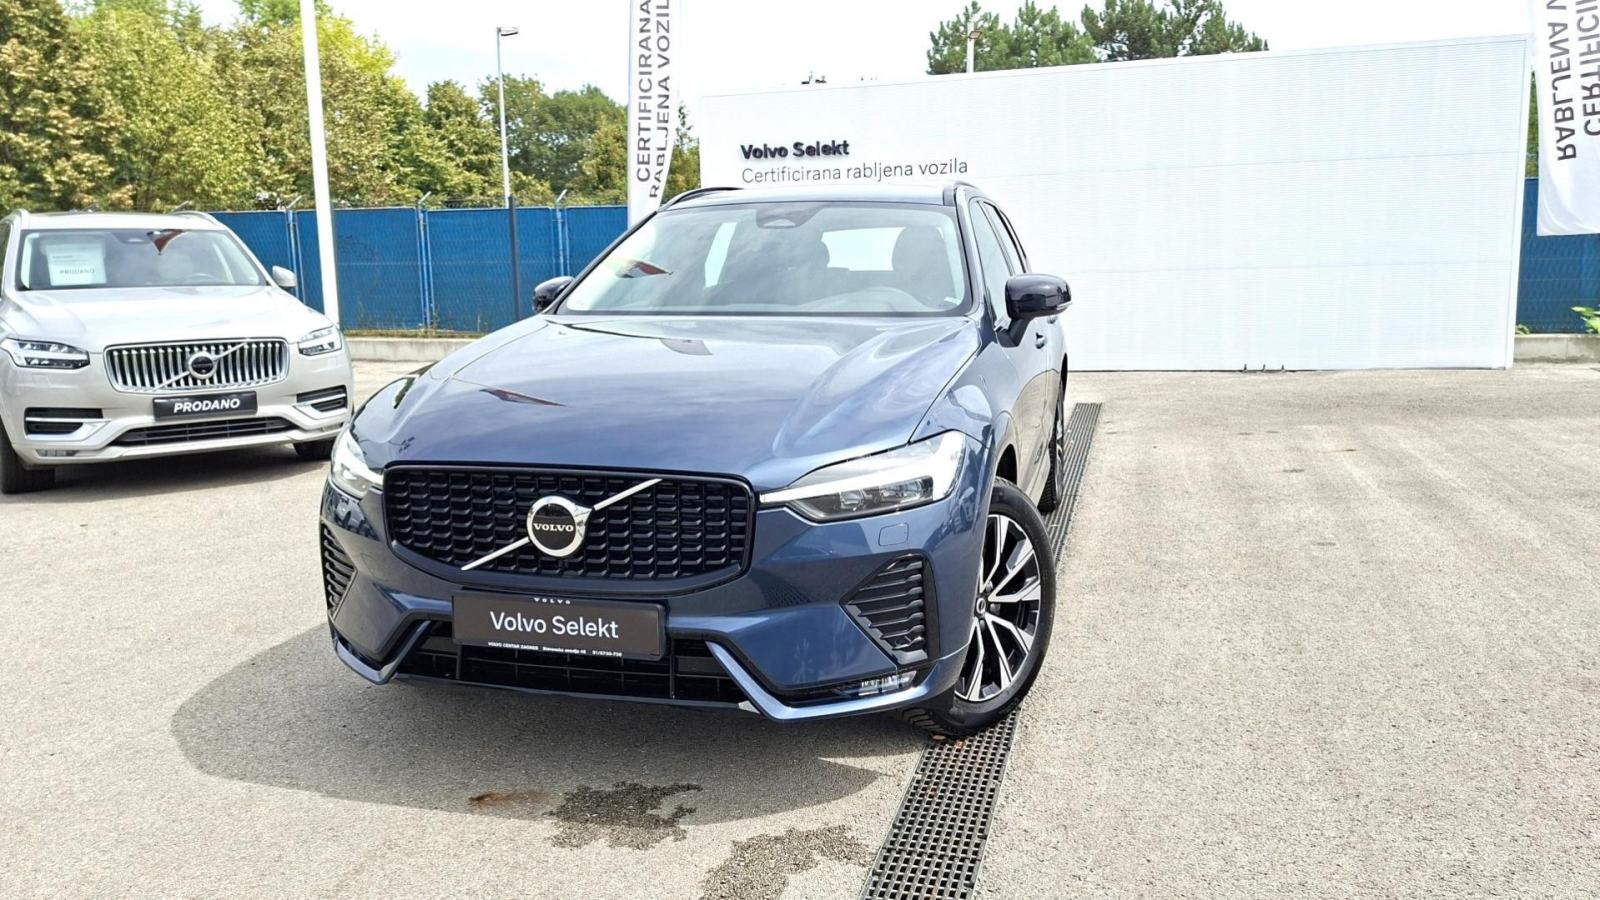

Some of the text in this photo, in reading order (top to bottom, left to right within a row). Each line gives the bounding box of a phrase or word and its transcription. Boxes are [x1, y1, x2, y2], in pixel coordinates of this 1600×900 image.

[636, 0, 652, 182] CERTIFICIRANA
[649, 76, 670, 198] RABLJENA
[740, 140, 850, 160] Volvo Selekt
[742, 158, 968, 184] Certificirana rabljena vozila
[173, 398, 240, 413] PRODANO
[533, 523, 574, 532] VOLVO
[533, 597, 571, 605] VOLVO
[489, 611, 619, 639] Volvo Selekt
